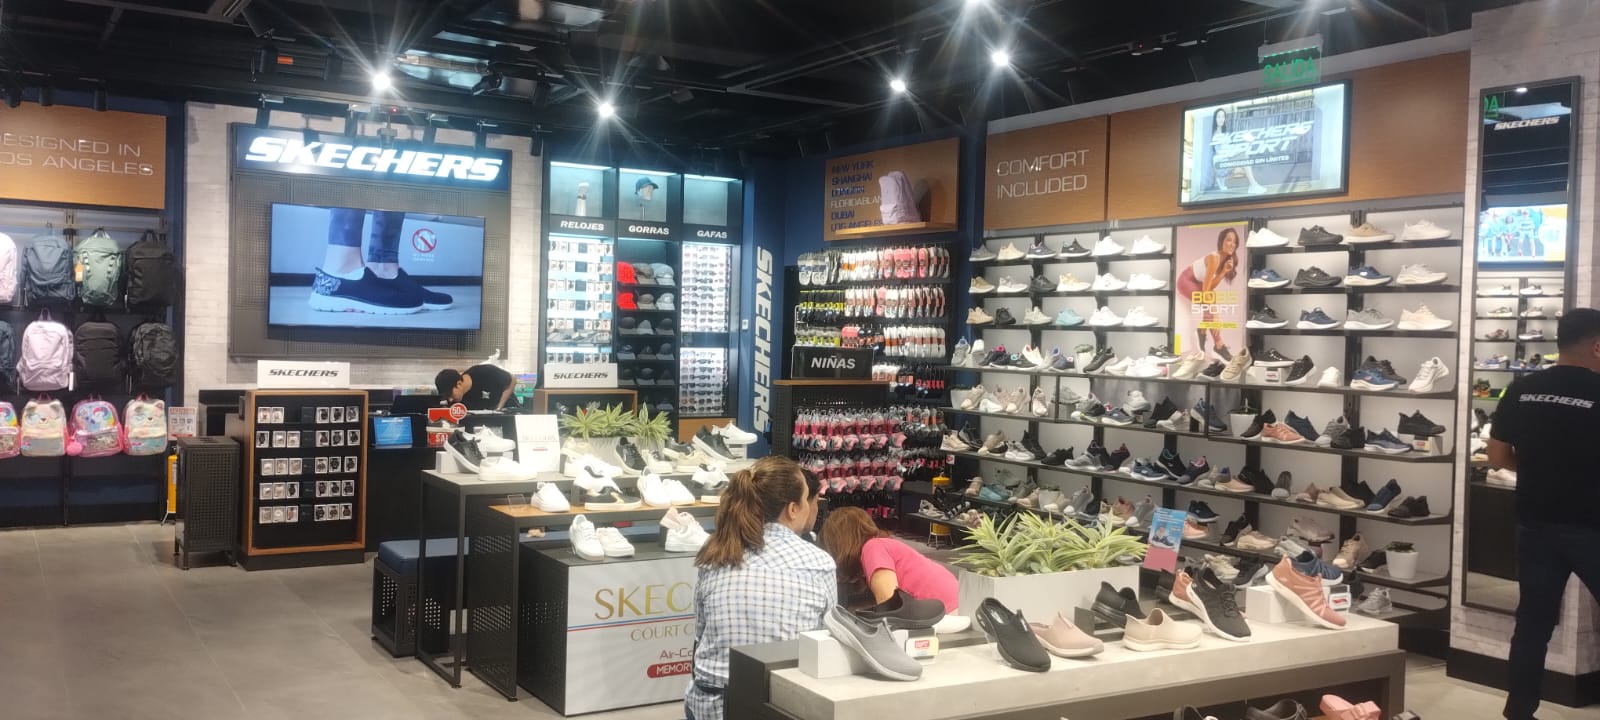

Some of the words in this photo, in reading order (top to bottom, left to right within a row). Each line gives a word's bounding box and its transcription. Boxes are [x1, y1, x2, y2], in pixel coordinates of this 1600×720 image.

[1263, 57, 1316, 82] SALIDA
[1494, 116, 1560, 131] SKECHERS
[1209, 120, 1315, 146] SKECHERS
[0, 132, 109, 154] ESIGNED
[118, 143, 141, 157] IN
[1214, 135, 1298, 159] SPORT
[42, 155, 154, 177] ANGELES
[245, 135, 503, 182] SKECHERS
[997, 149, 1090, 177] COMFORT
[997, 174, 1087, 199] INCLUDED
[560, 220, 605, 232] RELOJES
[628, 225, 670, 236] GORRAS
[696, 230, 728, 239] GAFAS
[1191, 304, 1239, 314] SPORT
[753, 246, 773, 433] SKECHERS
[811, 356, 856, 369] NIÑAS
[268, 368, 339, 378] SKECHERS
[553, 371, 609, 380] SKECHERS
[1519, 393, 1595, 408] SKECHERS
[630, 624, 680, 642] COURT
